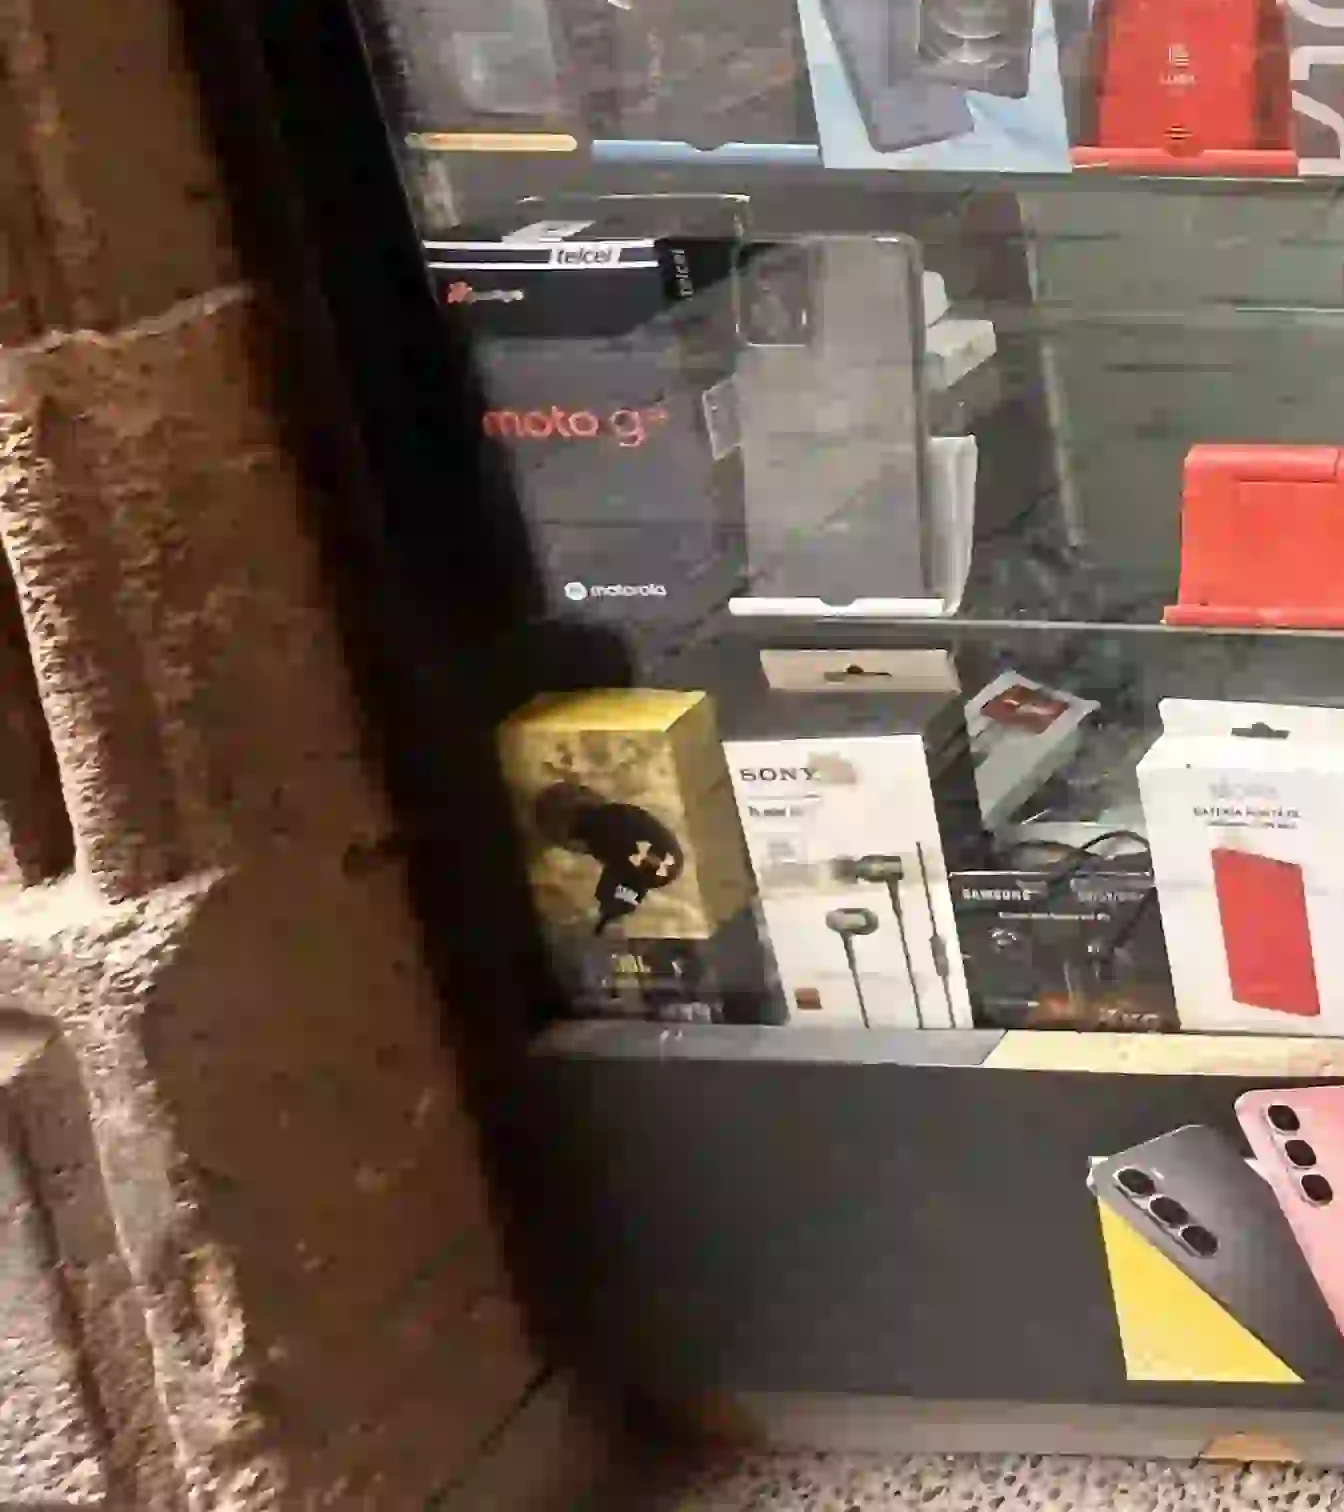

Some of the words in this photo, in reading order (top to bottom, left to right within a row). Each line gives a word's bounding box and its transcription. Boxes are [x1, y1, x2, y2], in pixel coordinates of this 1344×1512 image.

[482, 404, 599, 438] moto
[589, 582, 668, 599] motorola
[739, 766, 820, 782] SONY
